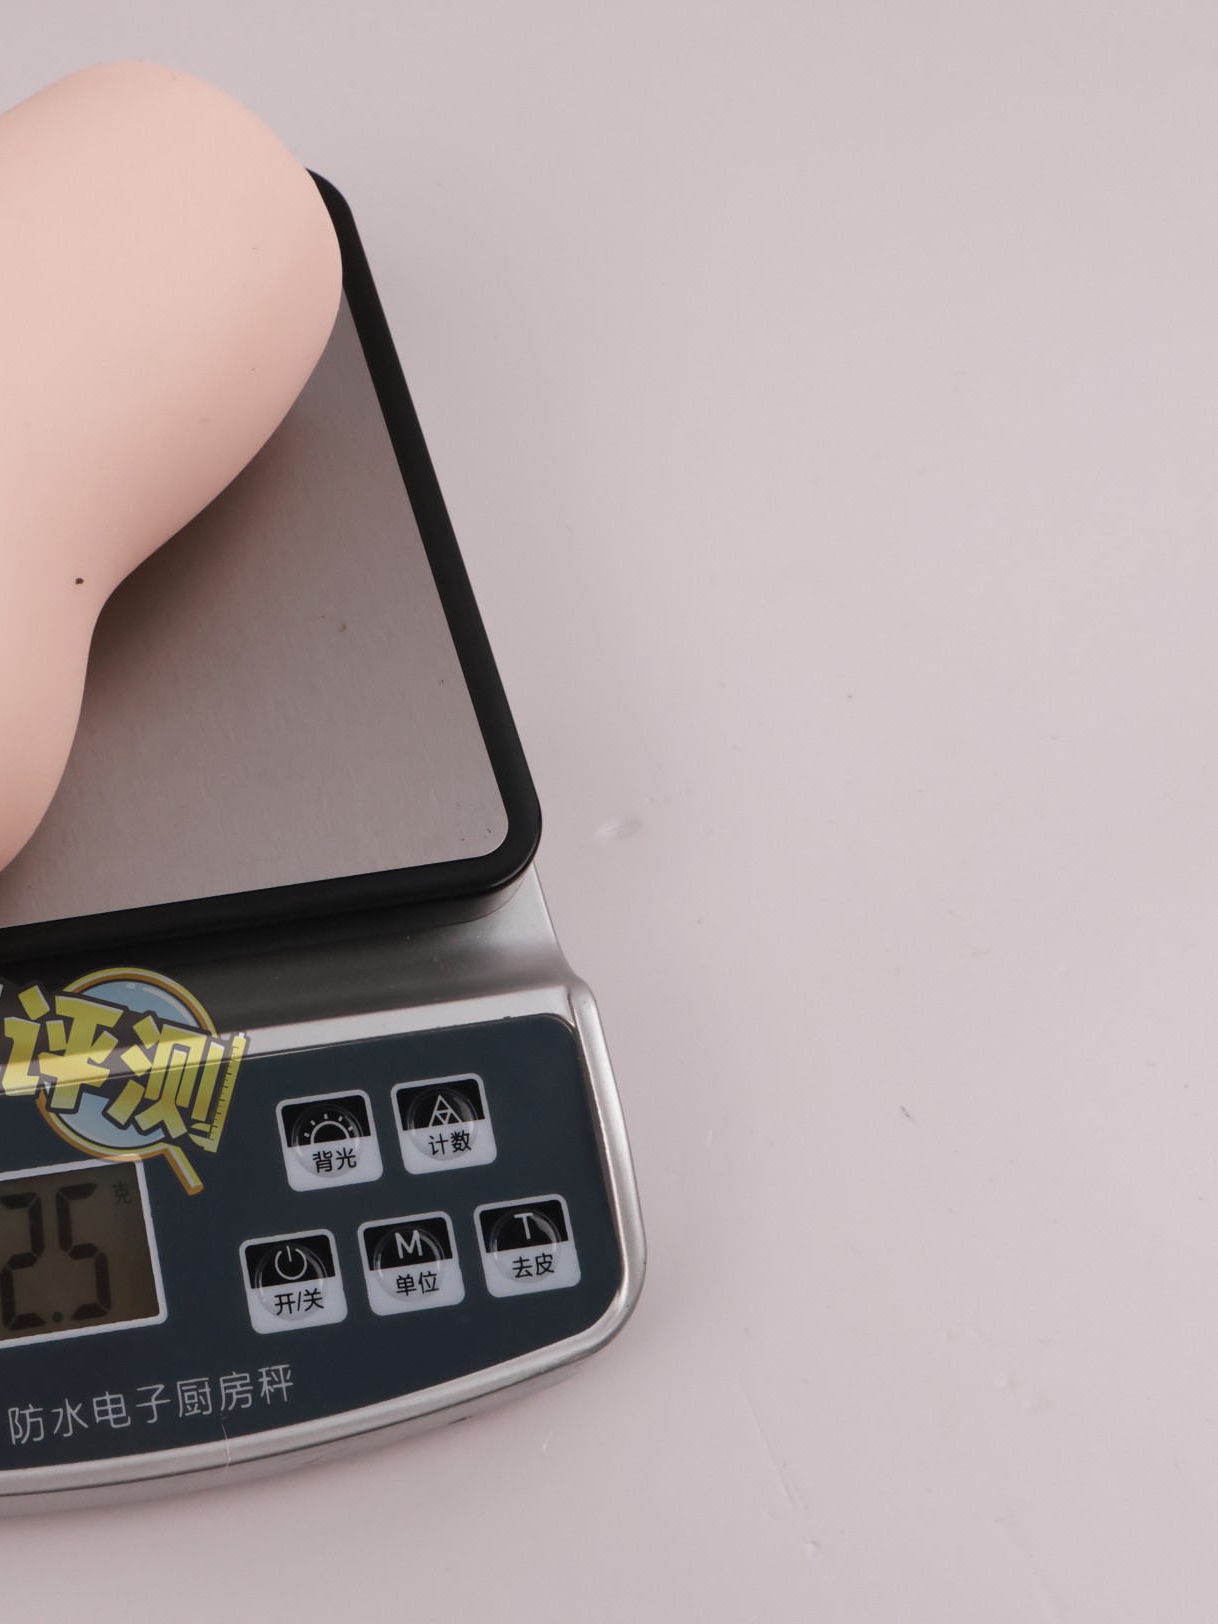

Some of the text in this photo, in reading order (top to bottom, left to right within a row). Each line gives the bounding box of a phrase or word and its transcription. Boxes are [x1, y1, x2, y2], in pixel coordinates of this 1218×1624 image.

[428, 1129, 472, 1155] 计数
[312, 1147, 357, 1173] 背光
[514, 1212, 534, 1241] T
[394, 1229, 424, 1260] M
[511, 1252, 555, 1279] 去皮
[395, 1270, 439, 1297] 单位
[274, 1287, 324, 1316] 开/关
[7, 1363, 295, 1446] 防水电子厨房秤
